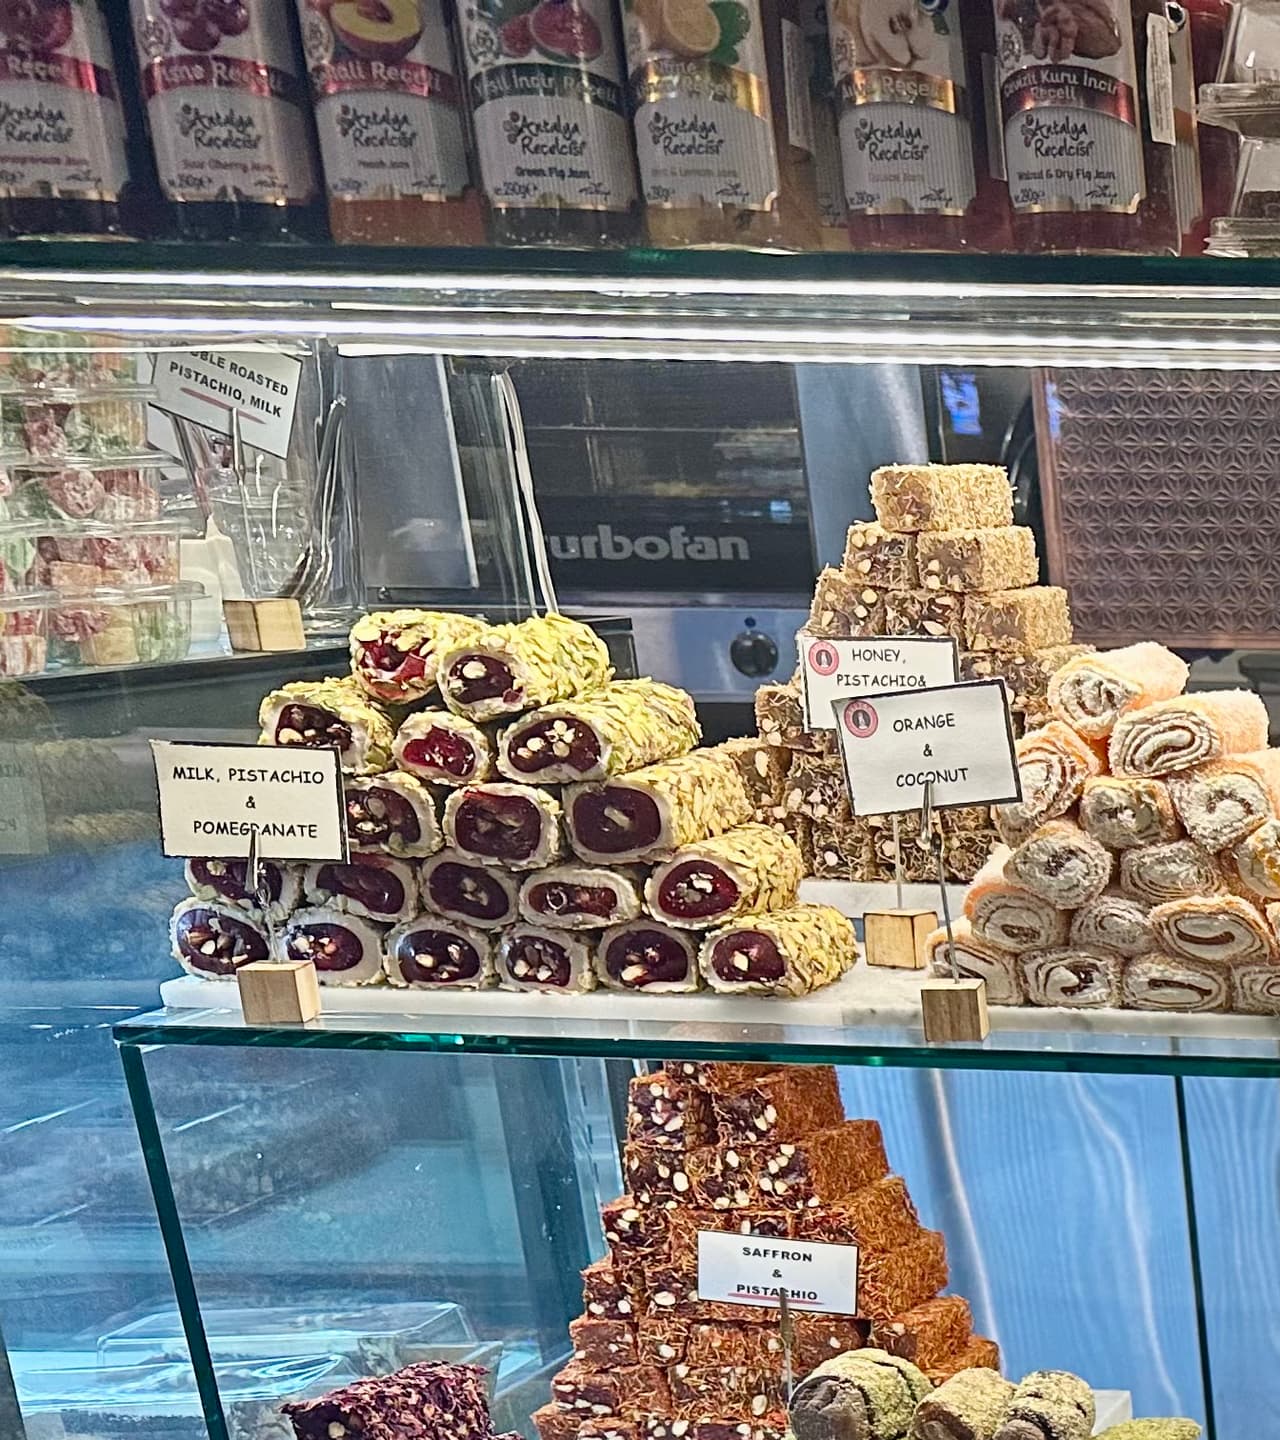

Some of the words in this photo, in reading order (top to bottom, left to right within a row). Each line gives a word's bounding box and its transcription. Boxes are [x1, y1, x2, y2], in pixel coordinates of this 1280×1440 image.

[1041, 69, 1079, 84] Kuru
[229, 361, 288, 396] ROASTED
[169, 361, 246, 405] PISTACHIO,
[249, 395, 282, 418] MILK
[546, 523, 750, 561] urbofan
[852, 648, 907, 664] HONEY,
[892, 712, 956, 732] ORANGE
[922, 743, 933, 757] &
[172, 766, 221, 783] MILK,
[228, 768, 325, 784] PISTACHIO
[896, 767, 969, 787] COCONUT
[245, 795, 256, 809] &
[742, 1246, 813, 1263] SAFFRON
[771, 1268, 783, 1279] &
